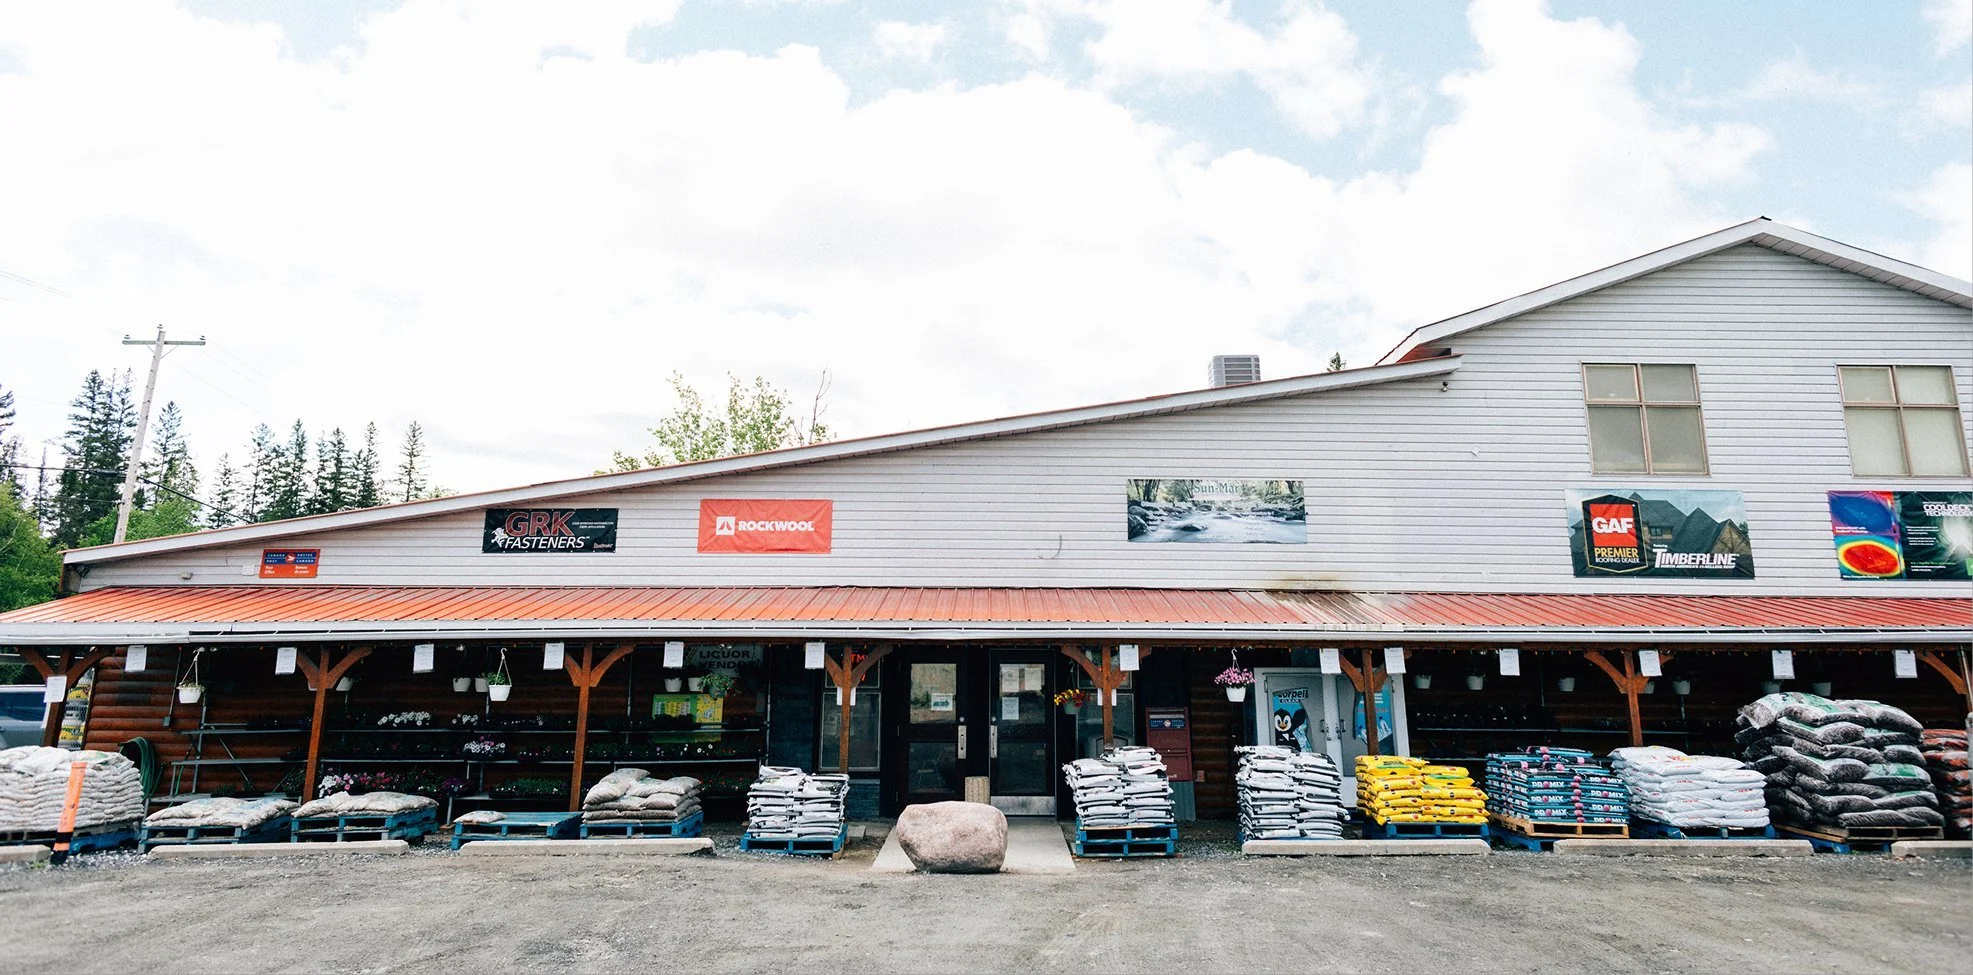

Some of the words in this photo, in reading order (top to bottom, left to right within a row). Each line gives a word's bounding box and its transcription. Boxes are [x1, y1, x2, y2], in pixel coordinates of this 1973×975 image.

[505, 511, 576, 537] GRK
[738, 520, 815, 532] ROCKWOOL
[1591, 517, 1634, 534] GAF
[504, 536, 585, 549] FASTENERS
[1594, 547, 1639, 558] PREMIER
[1652, 548, 1737, 568] TIMBERLINE
[700, 650, 751, 659] LIQUOR
